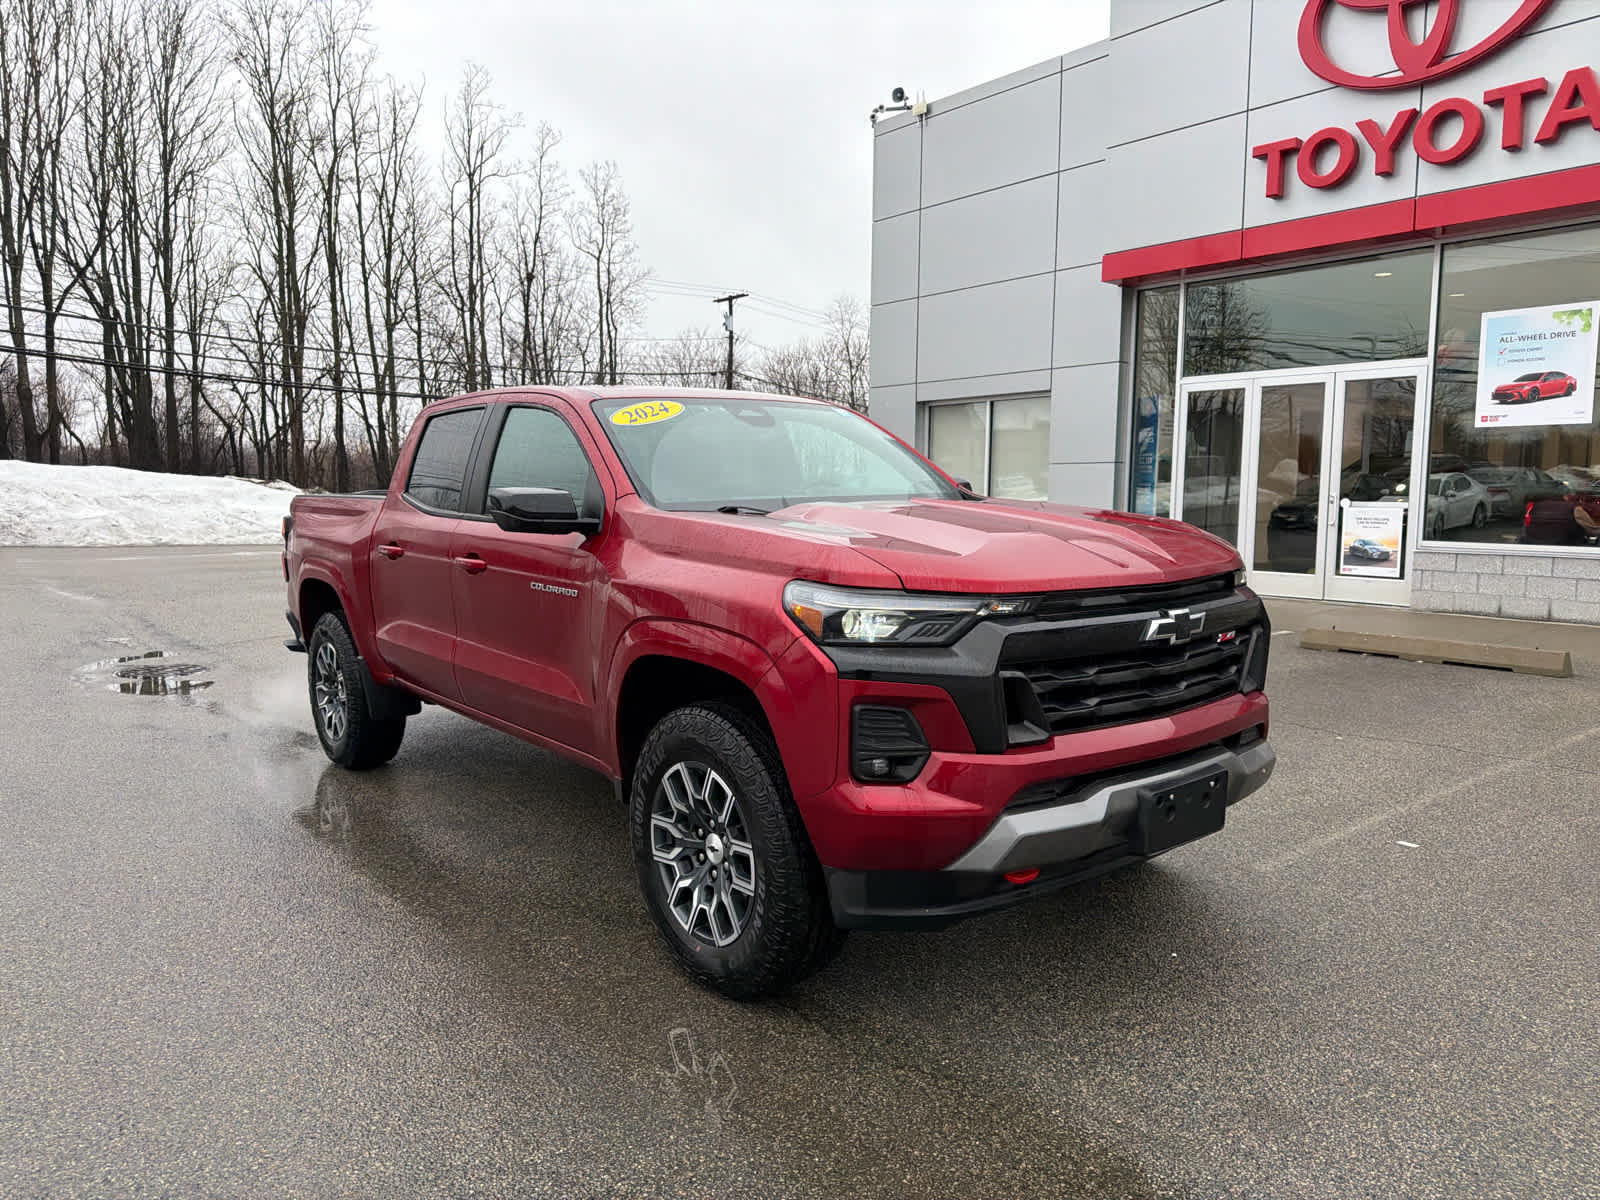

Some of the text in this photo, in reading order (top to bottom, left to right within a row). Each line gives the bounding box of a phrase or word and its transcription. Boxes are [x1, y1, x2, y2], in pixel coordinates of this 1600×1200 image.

[1253, 66, 1600, 198] TOYOTA
[1499, 330, 1577, 344] ALL-WHEEL DRIVE
[623, 402, 669, 424] 2024
[530, 581, 578, 597] COLORADO
